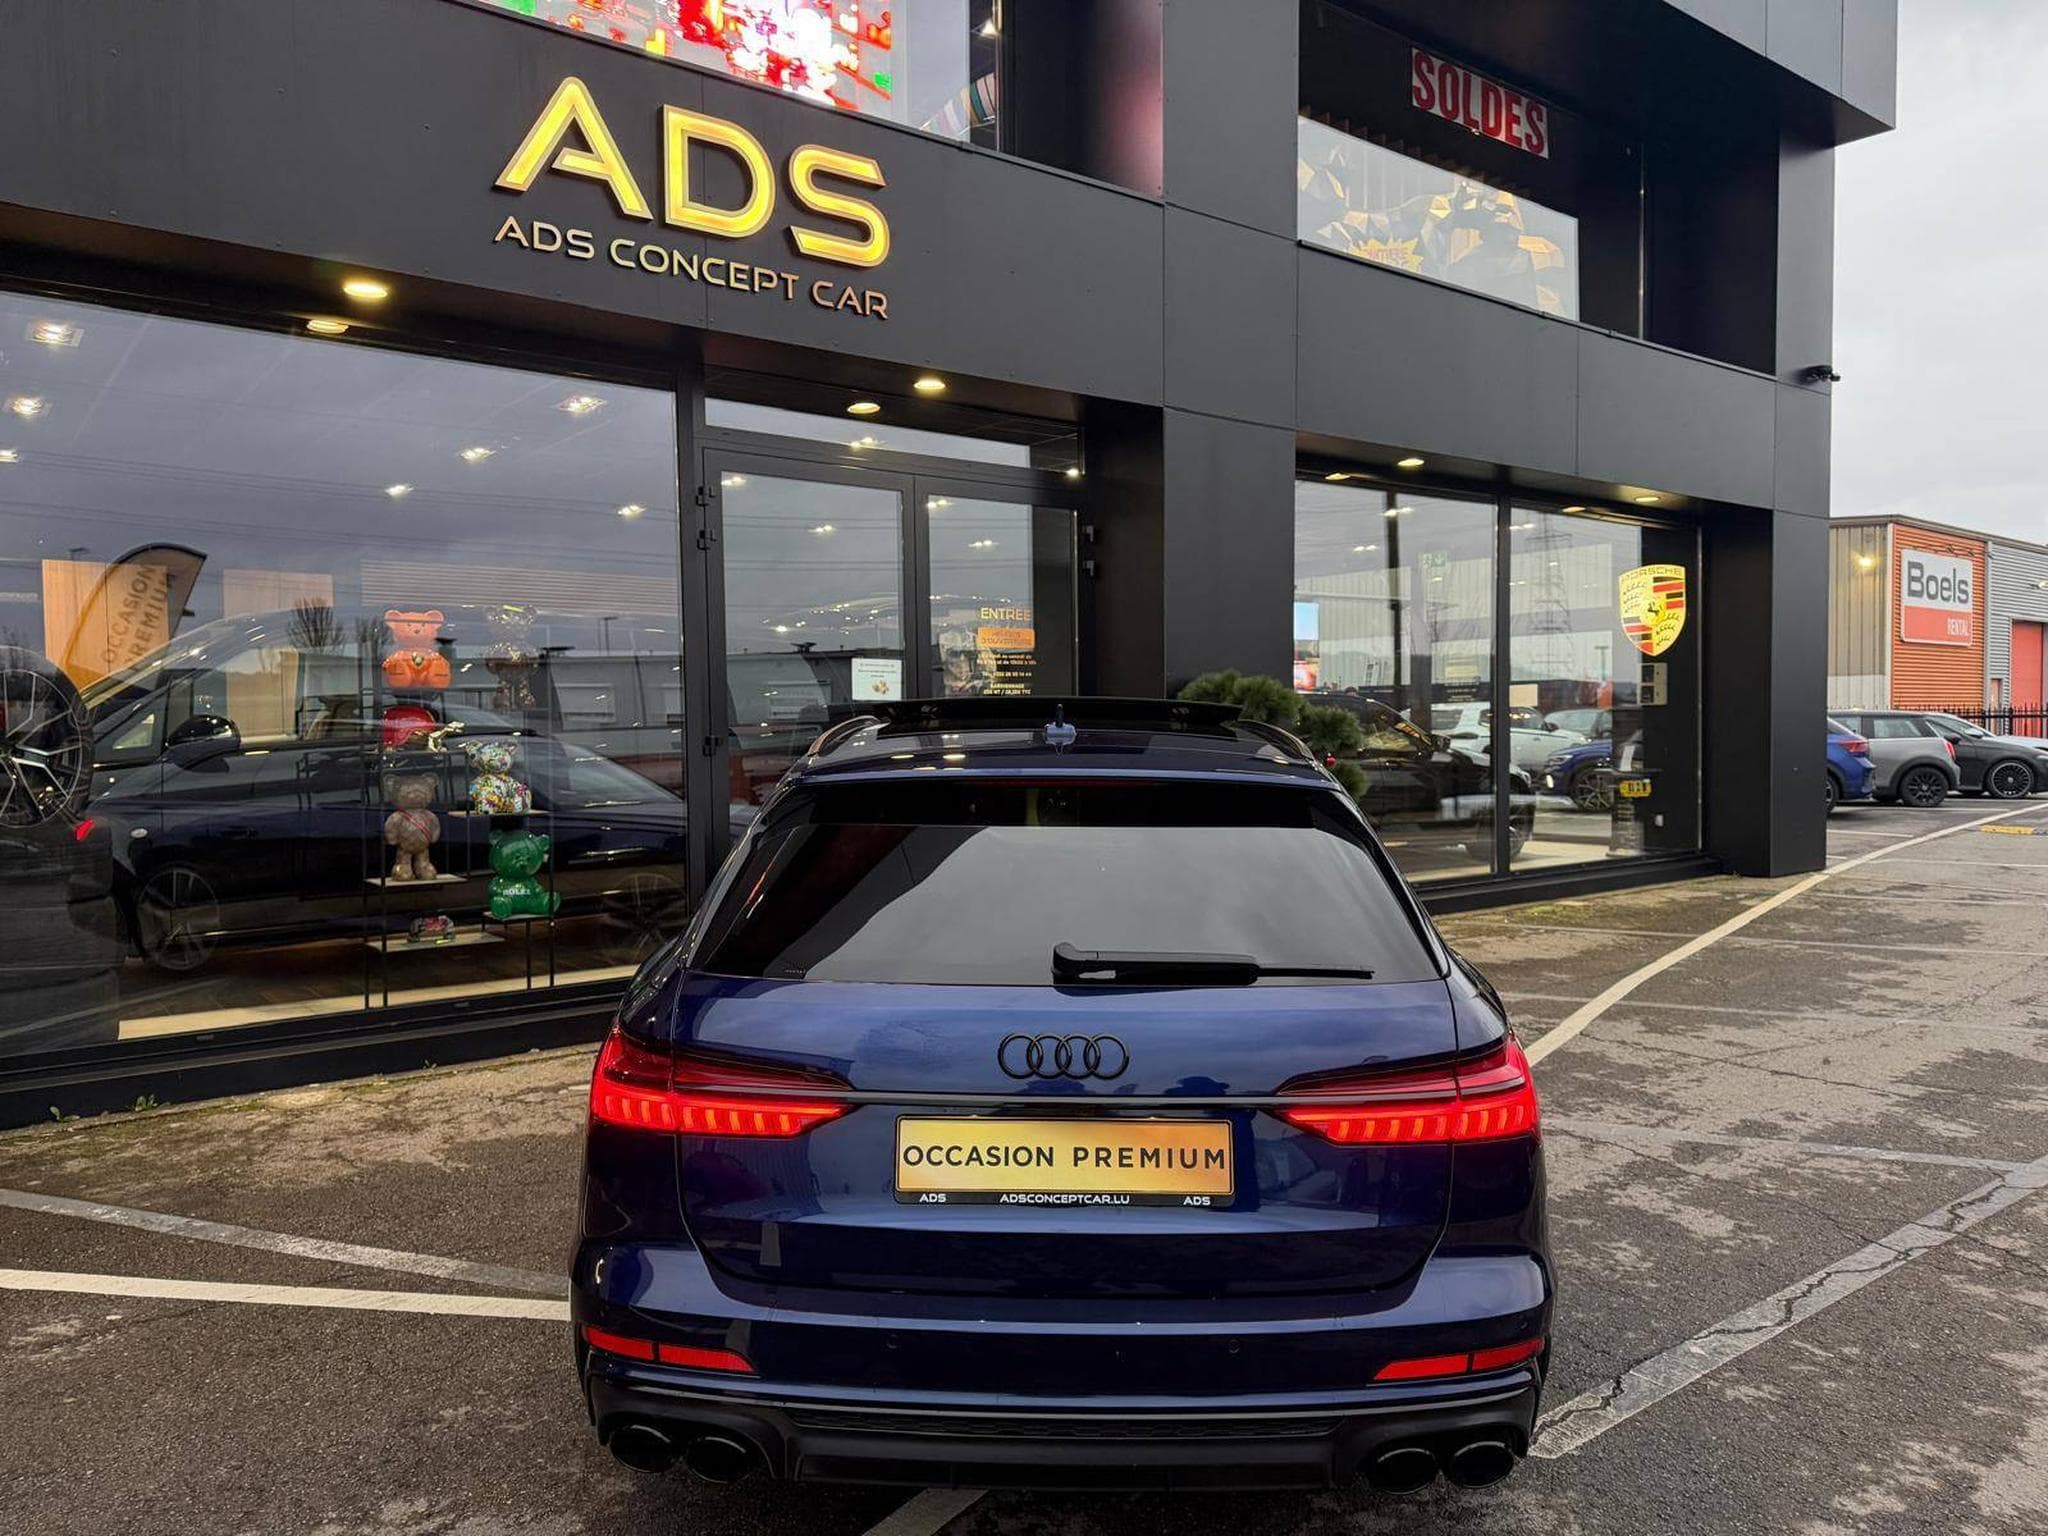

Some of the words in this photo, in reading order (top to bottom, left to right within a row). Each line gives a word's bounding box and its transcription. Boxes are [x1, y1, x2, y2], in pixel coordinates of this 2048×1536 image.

[1413, 51, 1545, 155] SOLDES
[495, 76, 889, 268] ADS
[494, 215, 595, 260] ADS
[609, 238, 800, 299] CONCEPT
[811, 280, 888, 319] CAR
[1907, 561, 1969, 604] Boels
[981, 607, 1031, 620] ENTREE
[1947, 618, 1969, 636] RENTAL
[903, 1146, 1054, 1167] OCCASION
[1073, 1147, 1225, 1169] PREMIUM
[919, 1194, 946, 1203] ADS
[1000, 1193, 1130, 1204] ADSCONCEPTCAR.LU
[1183, 1196, 1211, 1206] ADS
